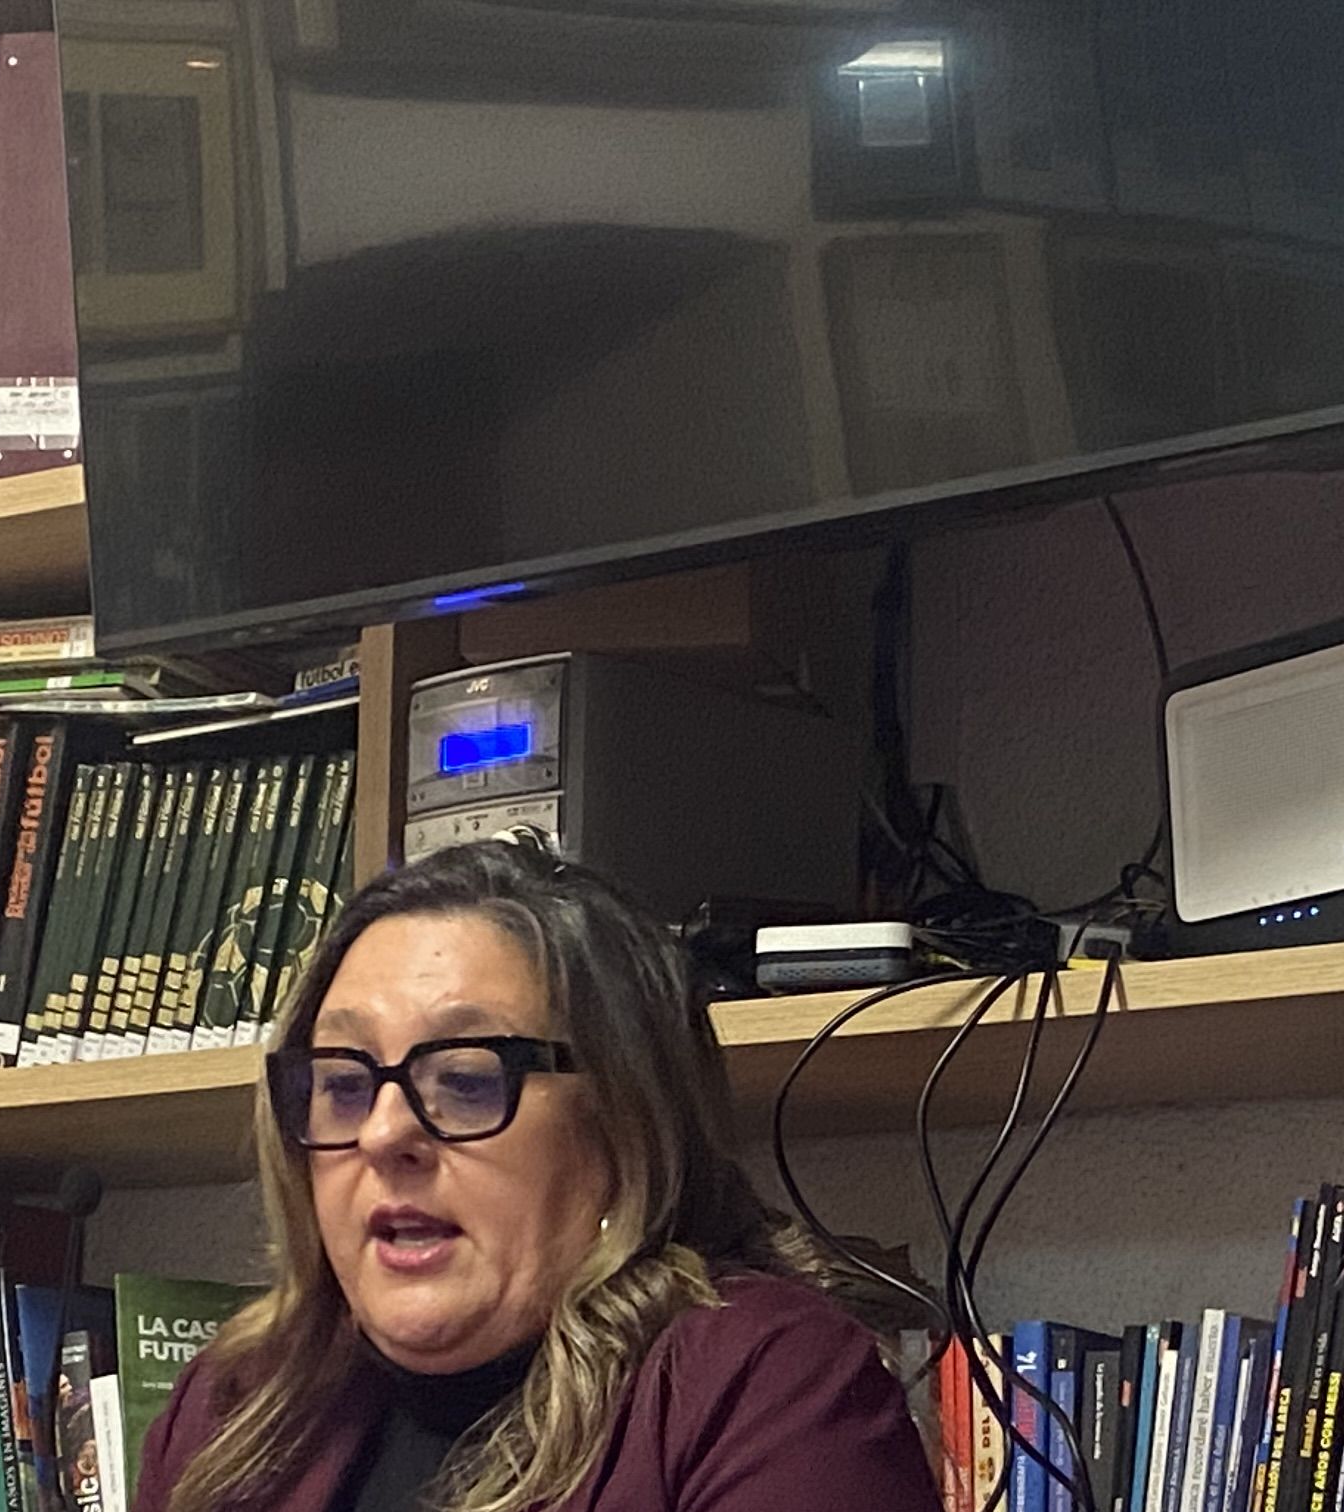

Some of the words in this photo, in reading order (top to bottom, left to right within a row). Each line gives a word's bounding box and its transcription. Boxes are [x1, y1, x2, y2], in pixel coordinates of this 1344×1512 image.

[467, 679, 490, 694] JVC
[138, 1315, 167, 1337] LA
[172, 1318, 220, 1340] CAS
[139, 1340, 201, 1363] FUTB
[1016, 1350, 1038, 1373] 14
[1197, 1376, 1214, 1414] haber
[1324, 1370, 1343, 1416] MESSI
[981, 1415, 992, 1449] DEL
[1270, 1434, 1285, 1459] DEL
[1320, 1417, 1335, 1449] CON
[1191, 1417, 1209, 1480] recordaré
[1315, 1450, 1332, 1490] AÑOS
